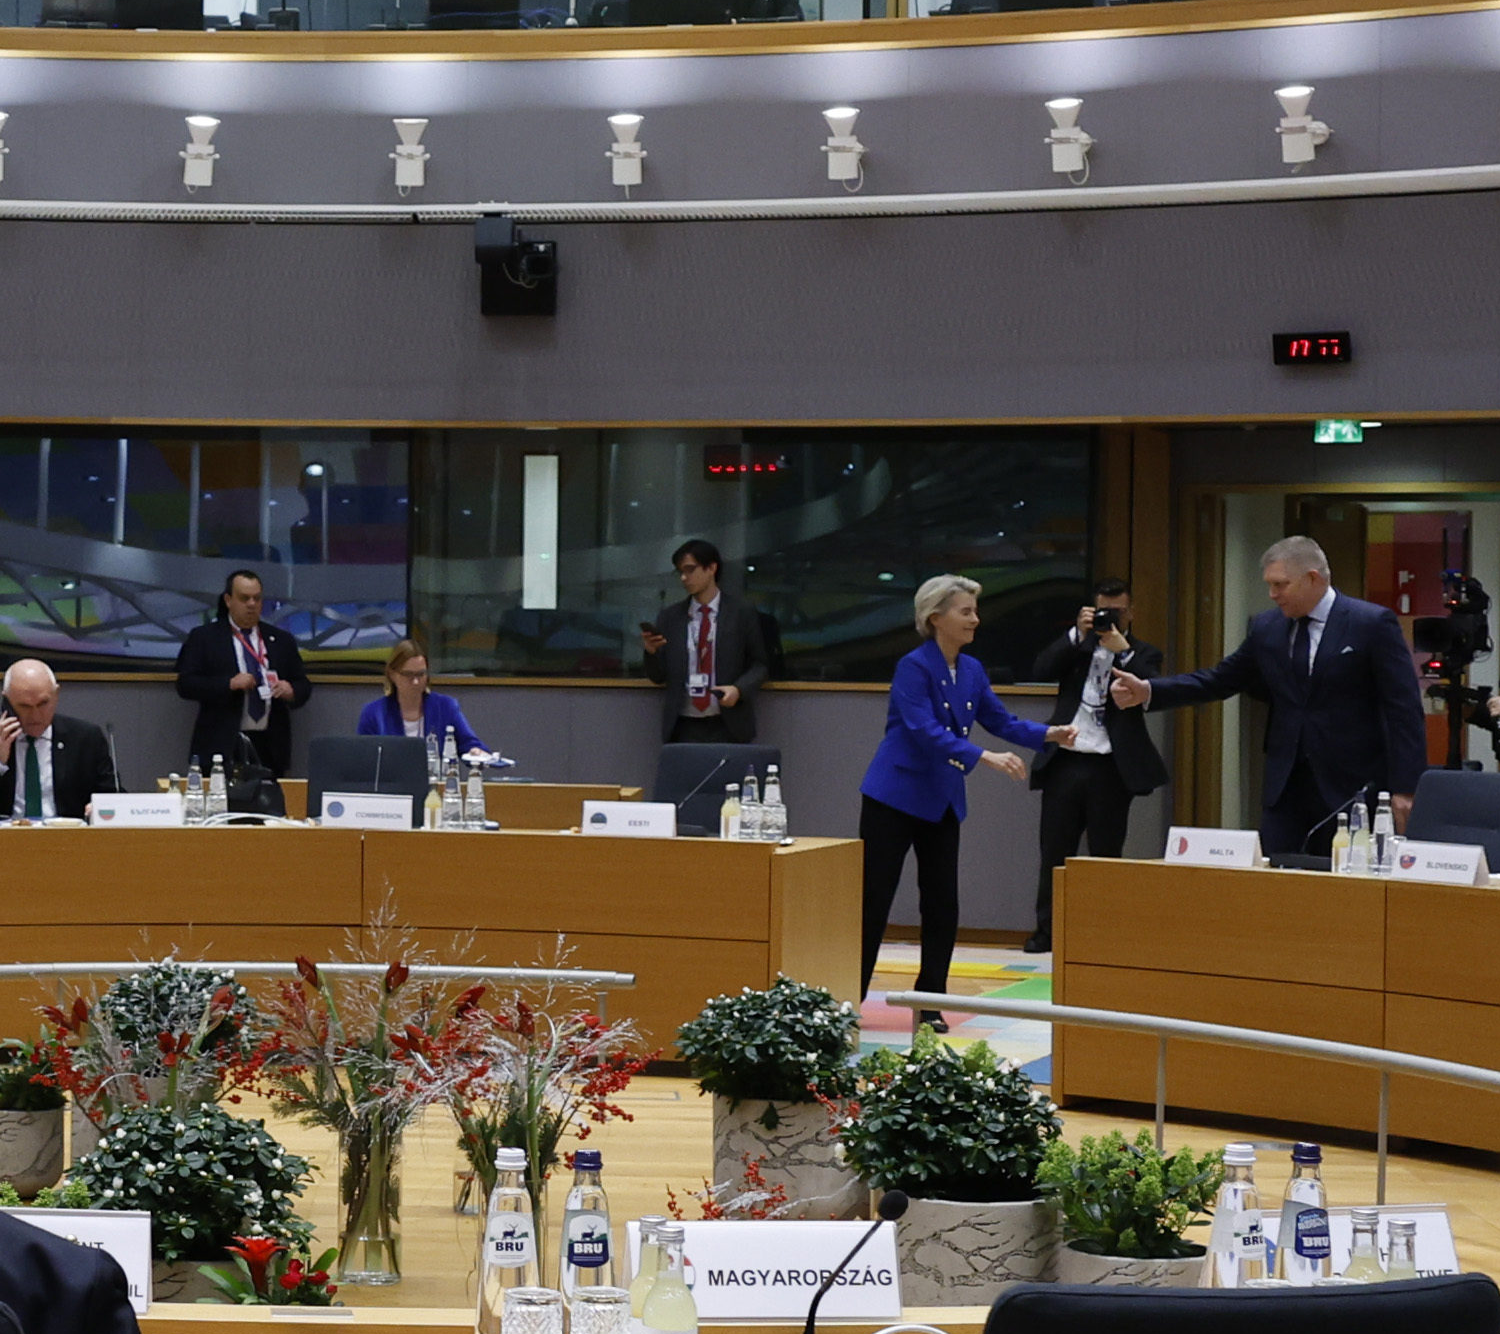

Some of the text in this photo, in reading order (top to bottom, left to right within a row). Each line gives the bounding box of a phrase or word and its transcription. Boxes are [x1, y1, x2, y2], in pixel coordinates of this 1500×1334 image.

[355, 811, 403, 819] COMMISSION
[628, 819, 651, 827] EESTI
[1209, 848, 1235, 856] MALTA
[1426, 861, 1469, 872] SLOVENSKO
[495, 1241, 525, 1252] BRU
[1301, 1236, 1330, 1247] BRU
[572, 1242, 604, 1254] BRU
[707, 1265, 893, 1286] MAGYARORSZÁG
